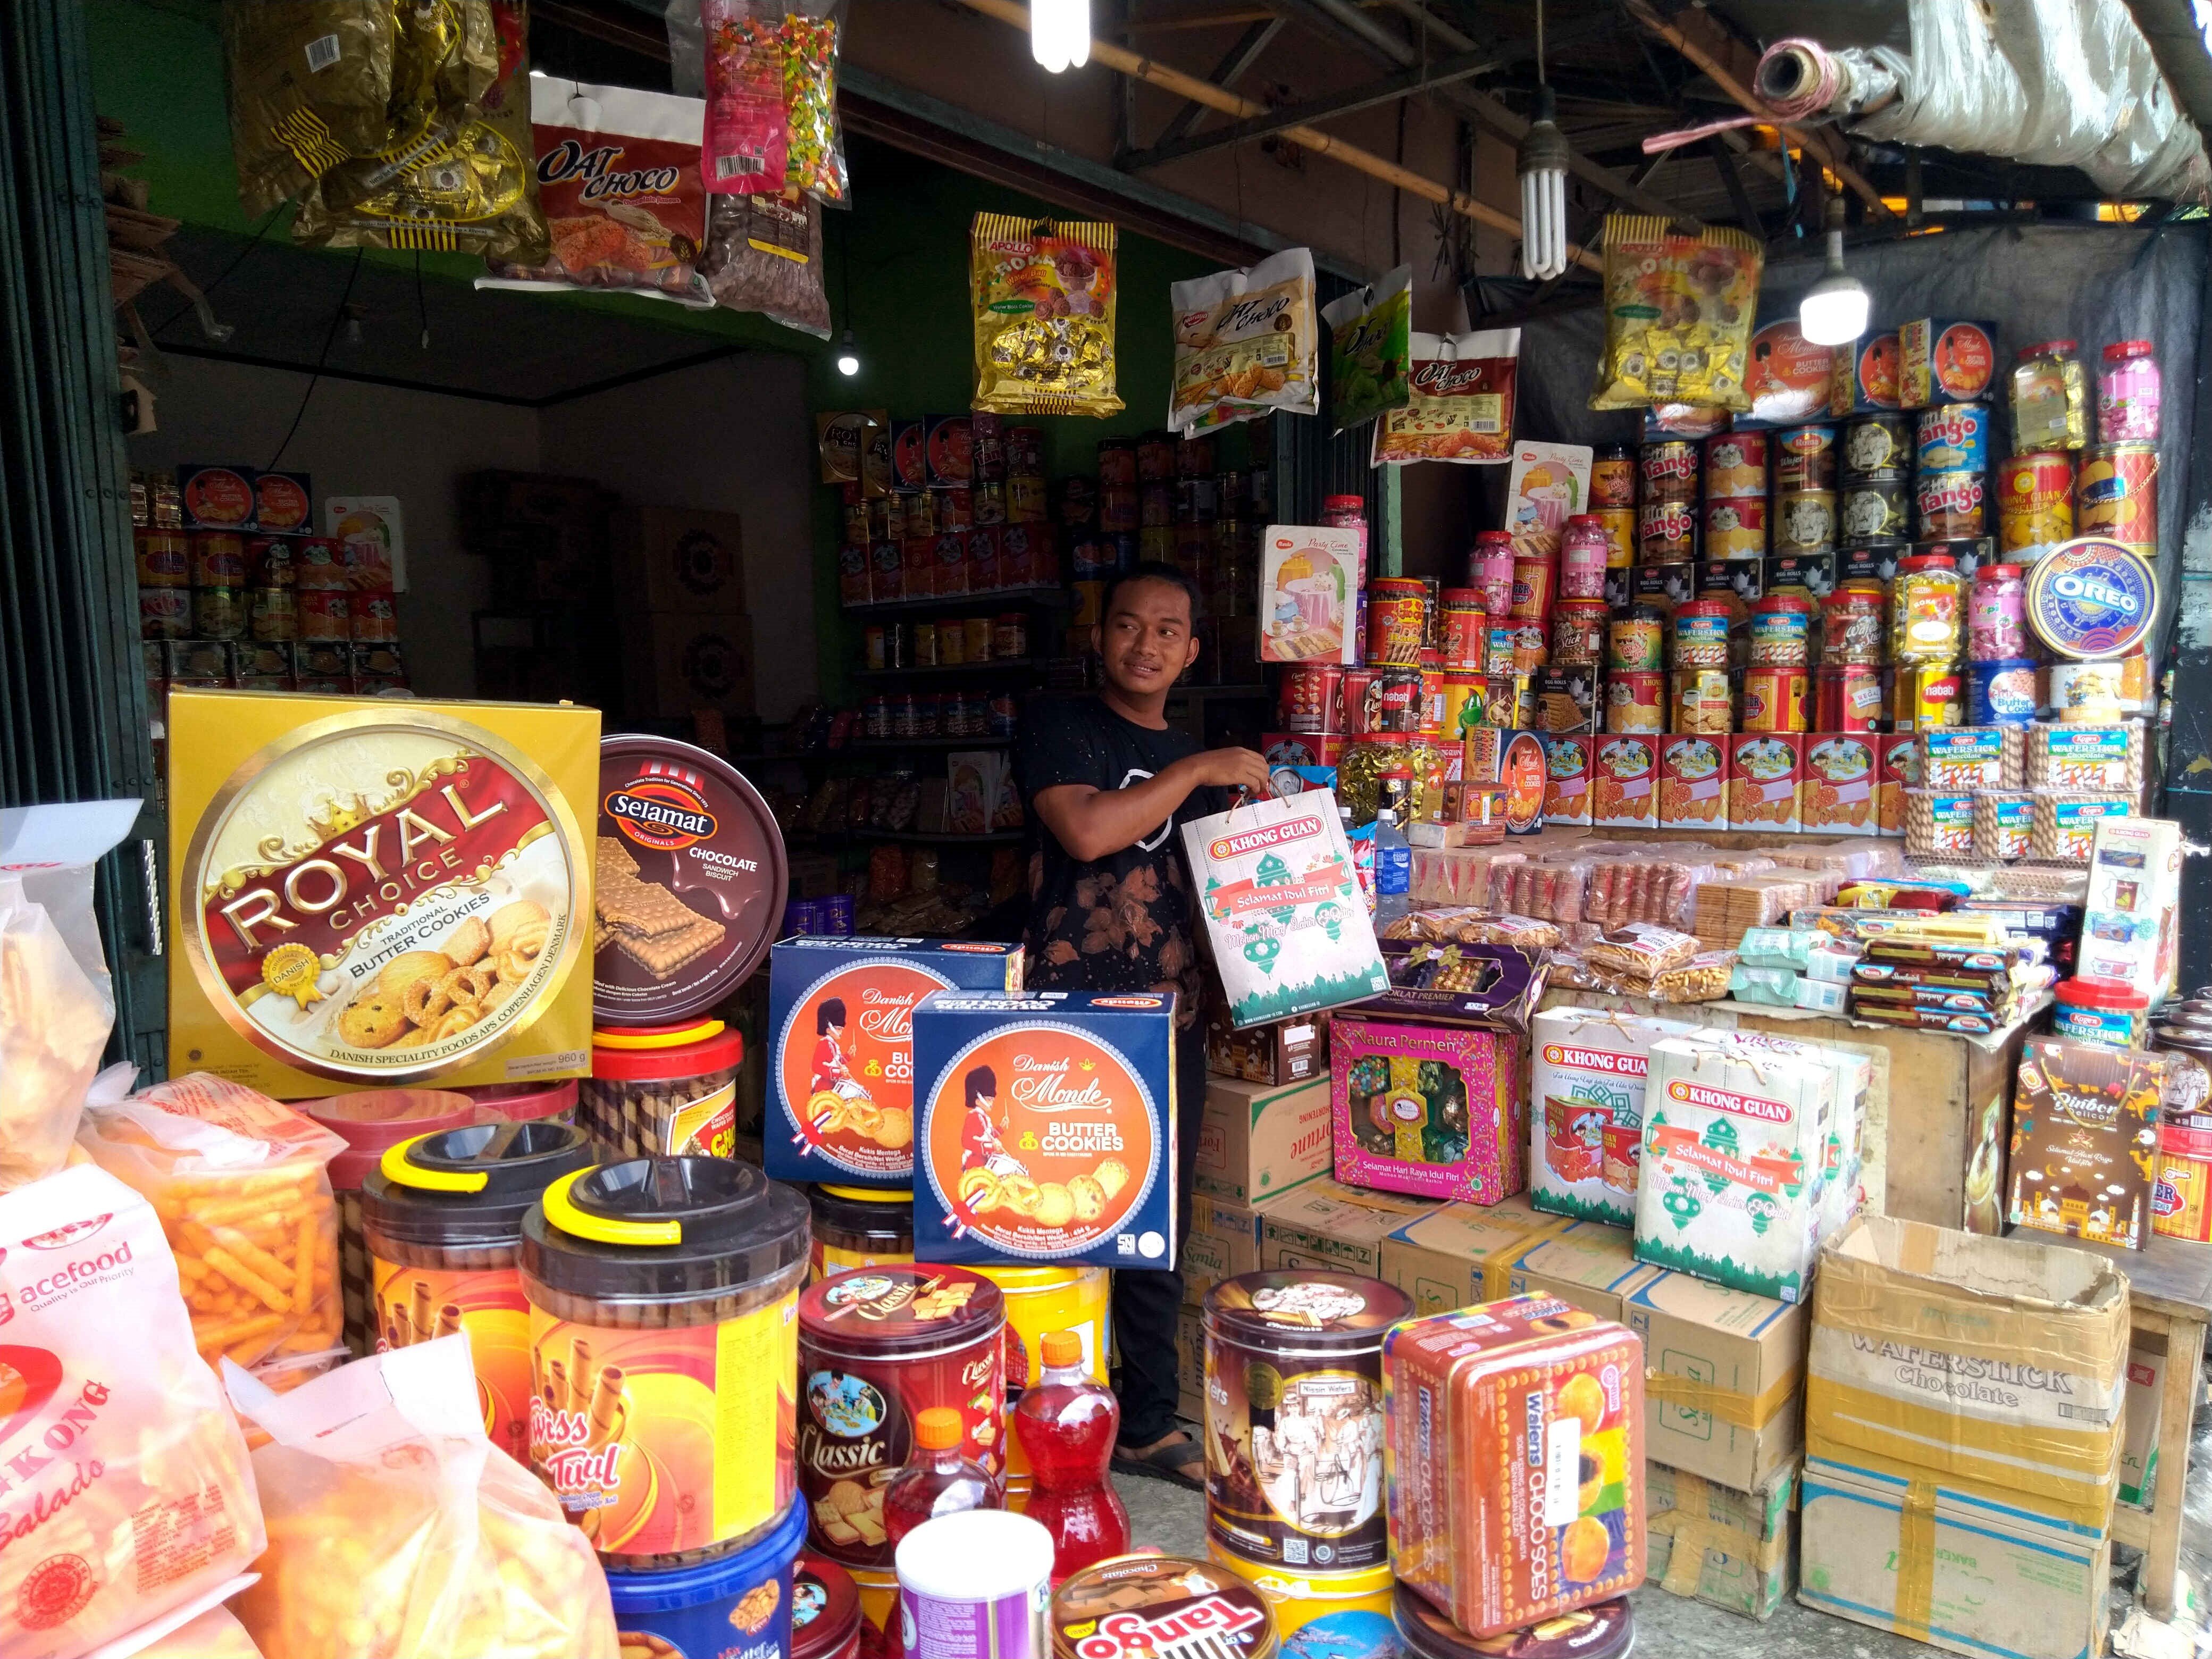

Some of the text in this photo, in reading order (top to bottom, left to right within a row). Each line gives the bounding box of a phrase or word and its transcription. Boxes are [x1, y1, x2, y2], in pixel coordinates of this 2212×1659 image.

[537, 140, 625, 184] OAT
[583, 167, 680, 198] CHOCO
[988, 241, 1034, 254] APOLLO
[994, 255, 1057, 276] ROKA
[1416, 363, 1457, 384] OAT
[1796, 358, 1829, 368] BUTTER
[1436, 368, 1481, 391] CHOCO
[1795, 437, 1820, 447] Roma
[1642, 454, 1698, 479] Tango
[1918, 483, 1982, 514] Tango
[2031, 490, 2061, 504] GUAN
[1308, 537, 1348, 550] Party Time
[2055, 575, 2136, 612] OREO
[1925, 684, 1954, 696] nabati
[1932, 745, 1997, 754] WAFERSTICK
[625, 777, 644, 788] Chocolate
[671, 780, 693, 793] Generations
[692, 790, 702, 800] Since
[615, 795, 708, 833] Selamat
[634, 831, 675, 846] ORIGINALS
[1229, 819, 1318, 853] KHONG GUAN
[221, 784, 508, 955] ROYAL
[689, 847, 758, 873] CHOCOLATE
[702, 864, 739, 877] SANDWICH
[706, 870, 733, 882] BISCUIT
[328, 848, 464, 931] CHOICE
[1237, 885, 1329, 908] Selamat Idul Fitri
[349, 893, 491, 978] BUTTER COOKIES
[379, 906, 448, 945] TRADITIONAL
[1225, 931, 1259, 950] Mohon
[1259, 924, 1286, 940] Maaf
[272, 953, 298, 971] ORIGINAL
[273, 958, 309, 984] DANISH
[330, 914, 567, 1064] DANISH SPECIALITY FOODS APS COPENHAGEN DENMARK
[638, 983, 661, 992] Chocolate
[862, 988, 914, 1006] Danish
[1386, 989, 1418, 999] OKLAT
[1418, 992, 1455, 1001] PREMIER
[1355, 1032, 1456, 1052] Naura Permen
[558, 1054, 586, 1064] 960 g
[1013, 1054, 1069, 1071] Danish
[1563, 1049, 1648, 1074] KHONG GUA
[1011, 1077, 1112, 1113] Monde
[1689, 1086, 1788, 1121] KHONG GUAN
[1049, 1122, 1117, 1137] BUTTER
[1041, 1136, 1124, 1151] COOKIES
[1363, 1161, 1460, 1182] Selamat Hari Raya Idul Fitri
[1675, 1144, 1774, 1187] Selamat Idul Fitri
[1649, 1173, 1686, 1196] Mohon
[1017, 1225, 1035, 1234] Kukis
[1183, 1245, 1222, 1270] Sania
[20, 1241, 133, 1305] acefood
[30, 1267, 135, 1313] Quality is Our Priority
[857, 1281, 917, 1320] Classic
[1851, 1333, 2073, 1395] WAFERSTICK
[1303, 1384, 1353, 1394] Nissin Wafers
[1893, 1364, 2019, 1409] Chocolate
[801, 1423, 887, 1479] Classic
[1516, 1434, 1524, 1456] SOES
[547, 1444, 619, 1488] Tuul
[1516, 1457, 1525, 1487] KERING
[1528, 1393, 1548, 1601] Walens CHOCO SOES
[1101, 1564, 1158, 1580] Chocolate
